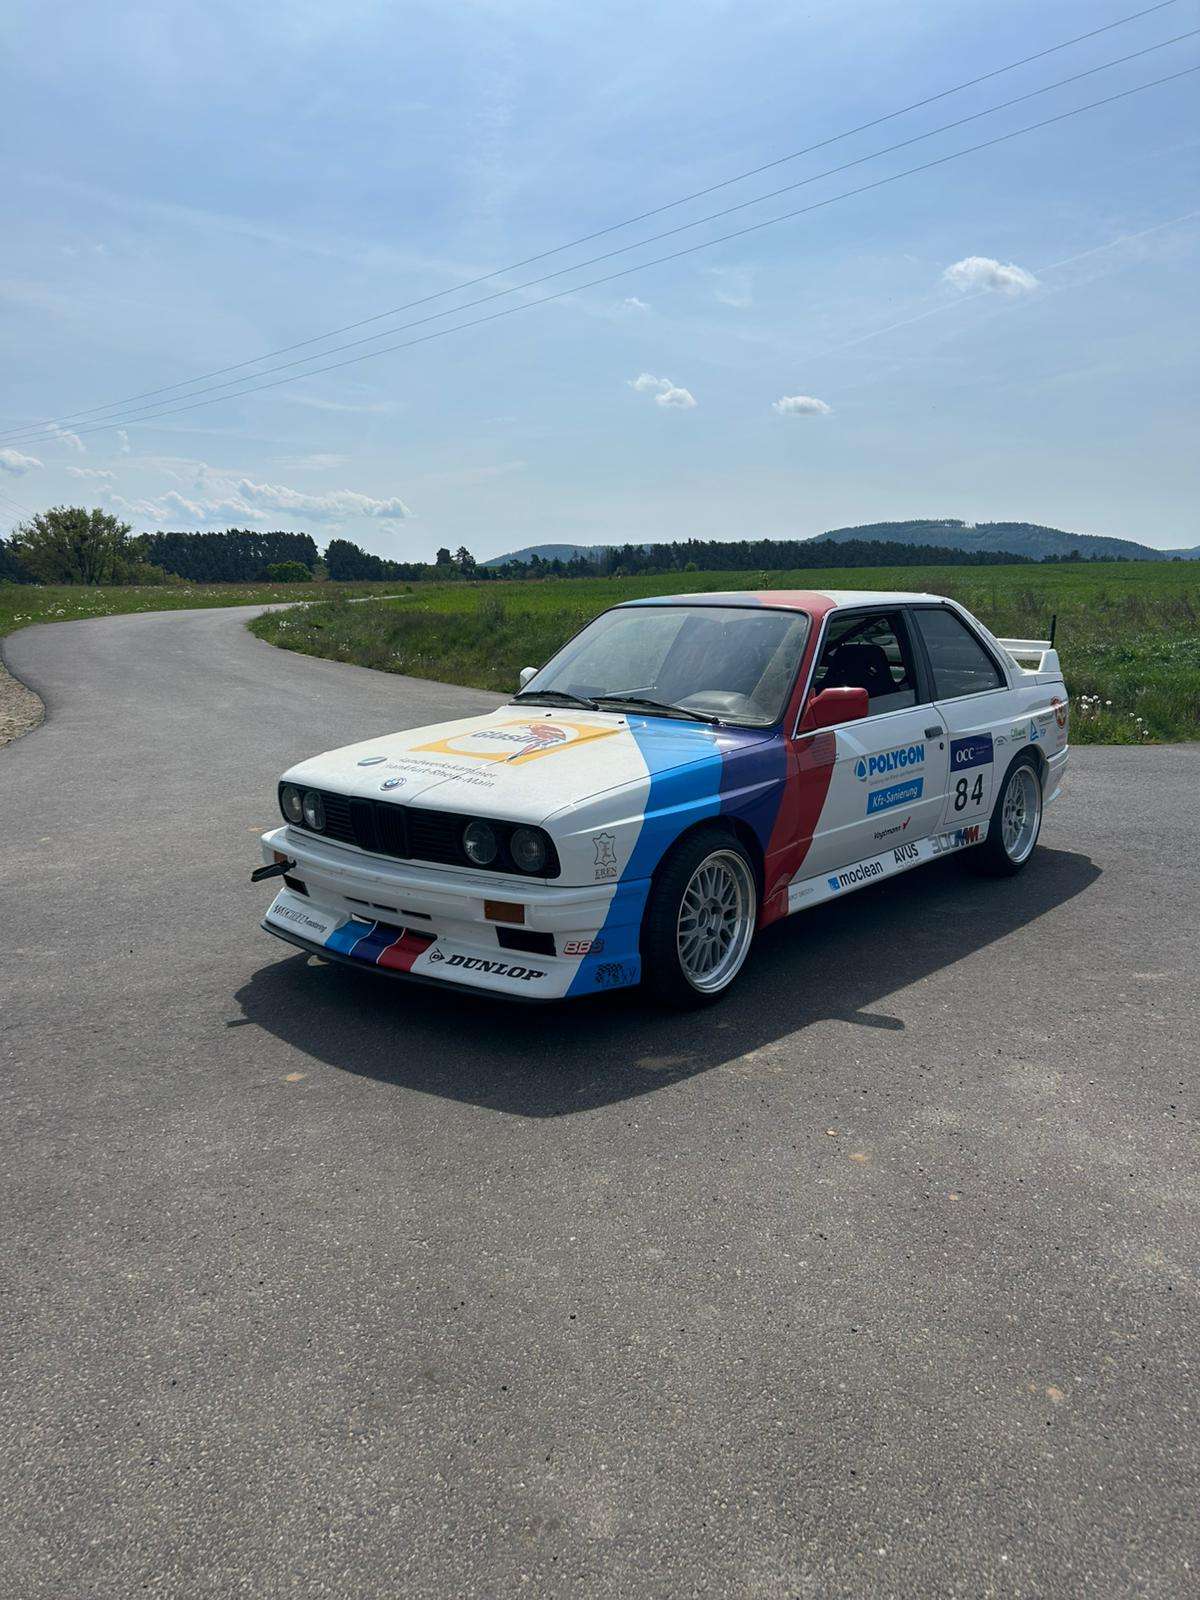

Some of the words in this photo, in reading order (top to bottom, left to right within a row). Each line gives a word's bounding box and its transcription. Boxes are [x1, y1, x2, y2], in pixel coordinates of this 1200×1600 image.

[869, 744, 924, 776] POLYGON
[872, 787, 917, 807] Kfz-Sanierung
[954, 773, 983, 811] 84
[893, 843, 919, 864] AVUS
[839, 861, 884, 888] moclean
[445, 954, 545, 981] DUNLOP
